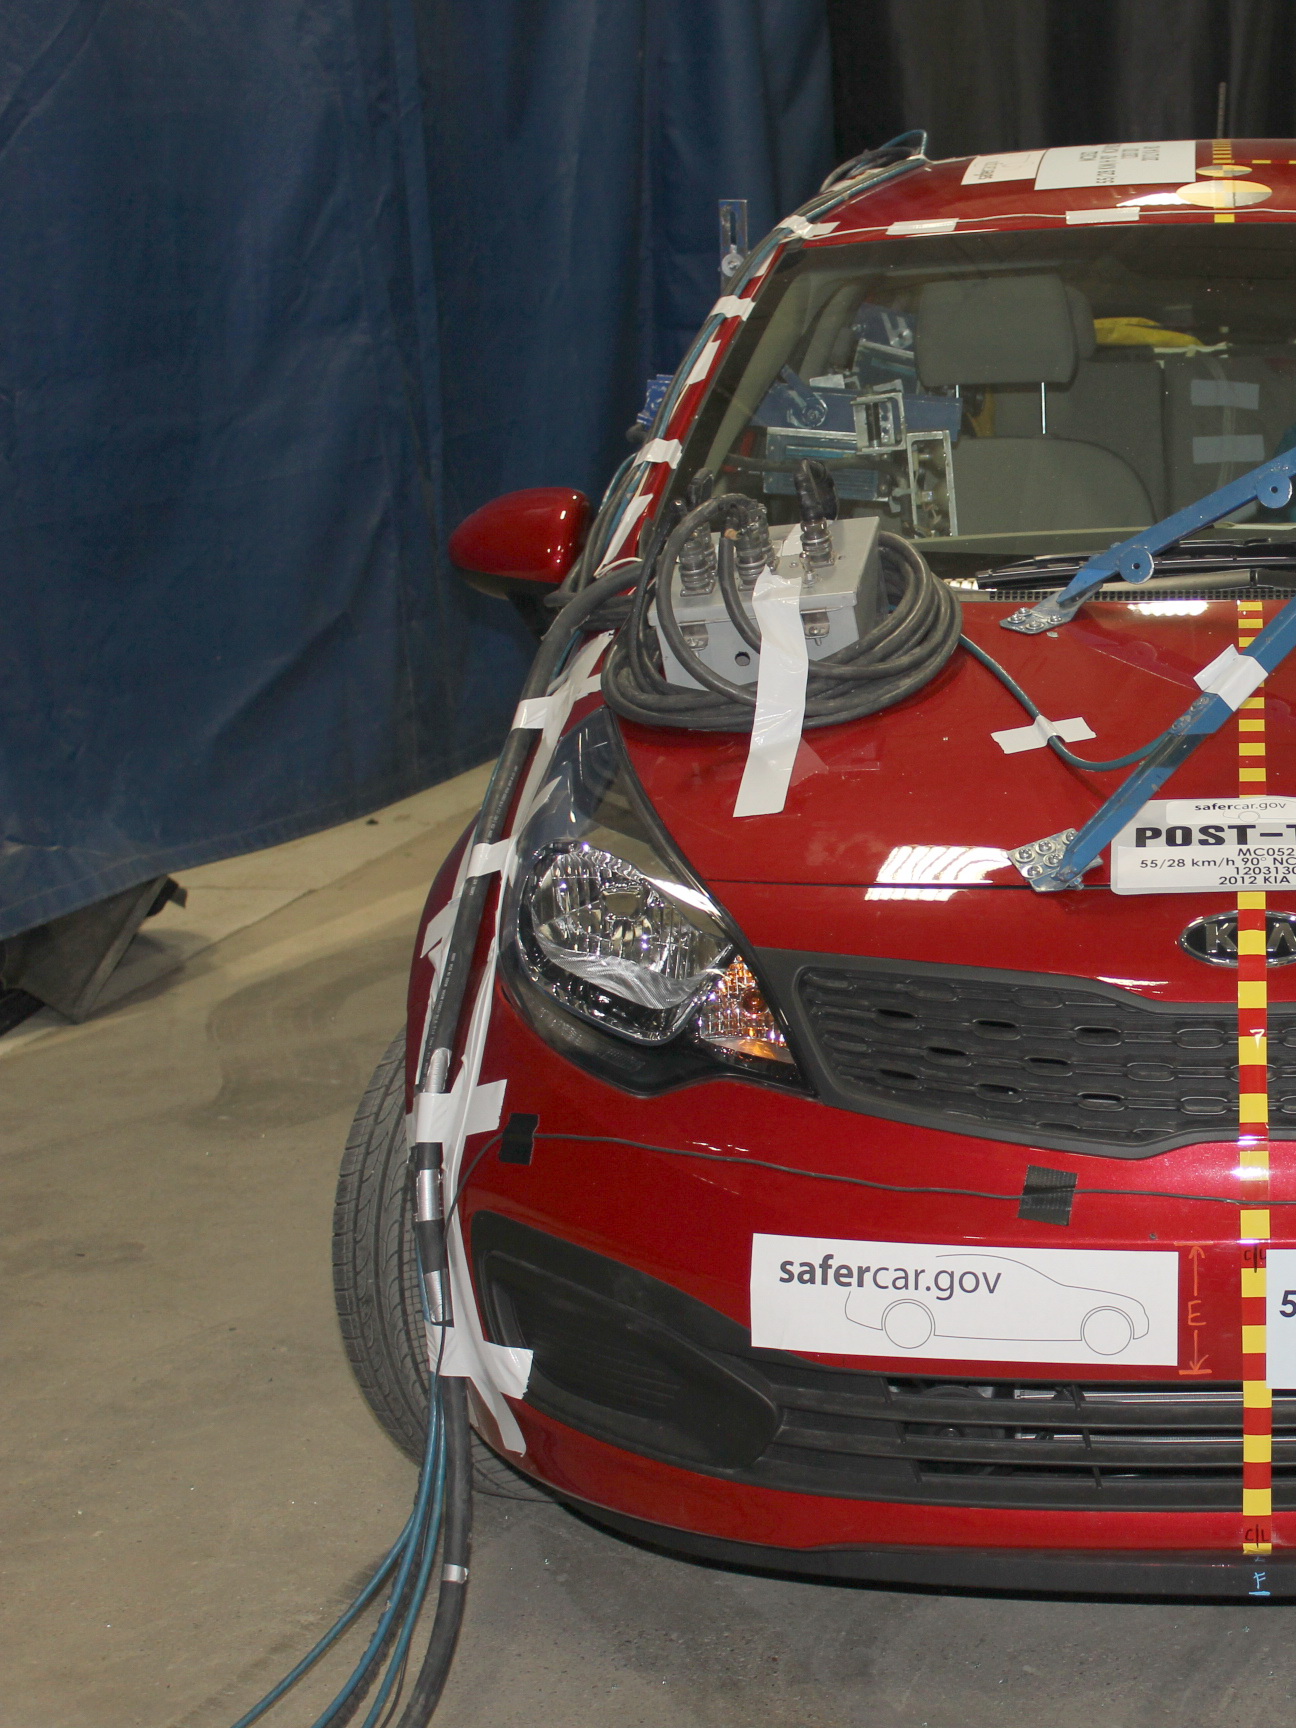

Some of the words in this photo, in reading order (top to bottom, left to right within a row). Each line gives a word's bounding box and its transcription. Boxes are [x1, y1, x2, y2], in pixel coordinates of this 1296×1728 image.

[1194, 802, 1287, 811] safercar.gov
[1140, 858, 1186, 869] 55/28
[1191, 857, 1235, 868] km/h
[1241, 857, 1267, 866] 90°
[1219, 876, 1257, 885] 2012
[1263, 875, 1290, 884] KIA
[779, 1254, 1002, 1301] safercar.gov
[1187, 1299, 1207, 1326] E
